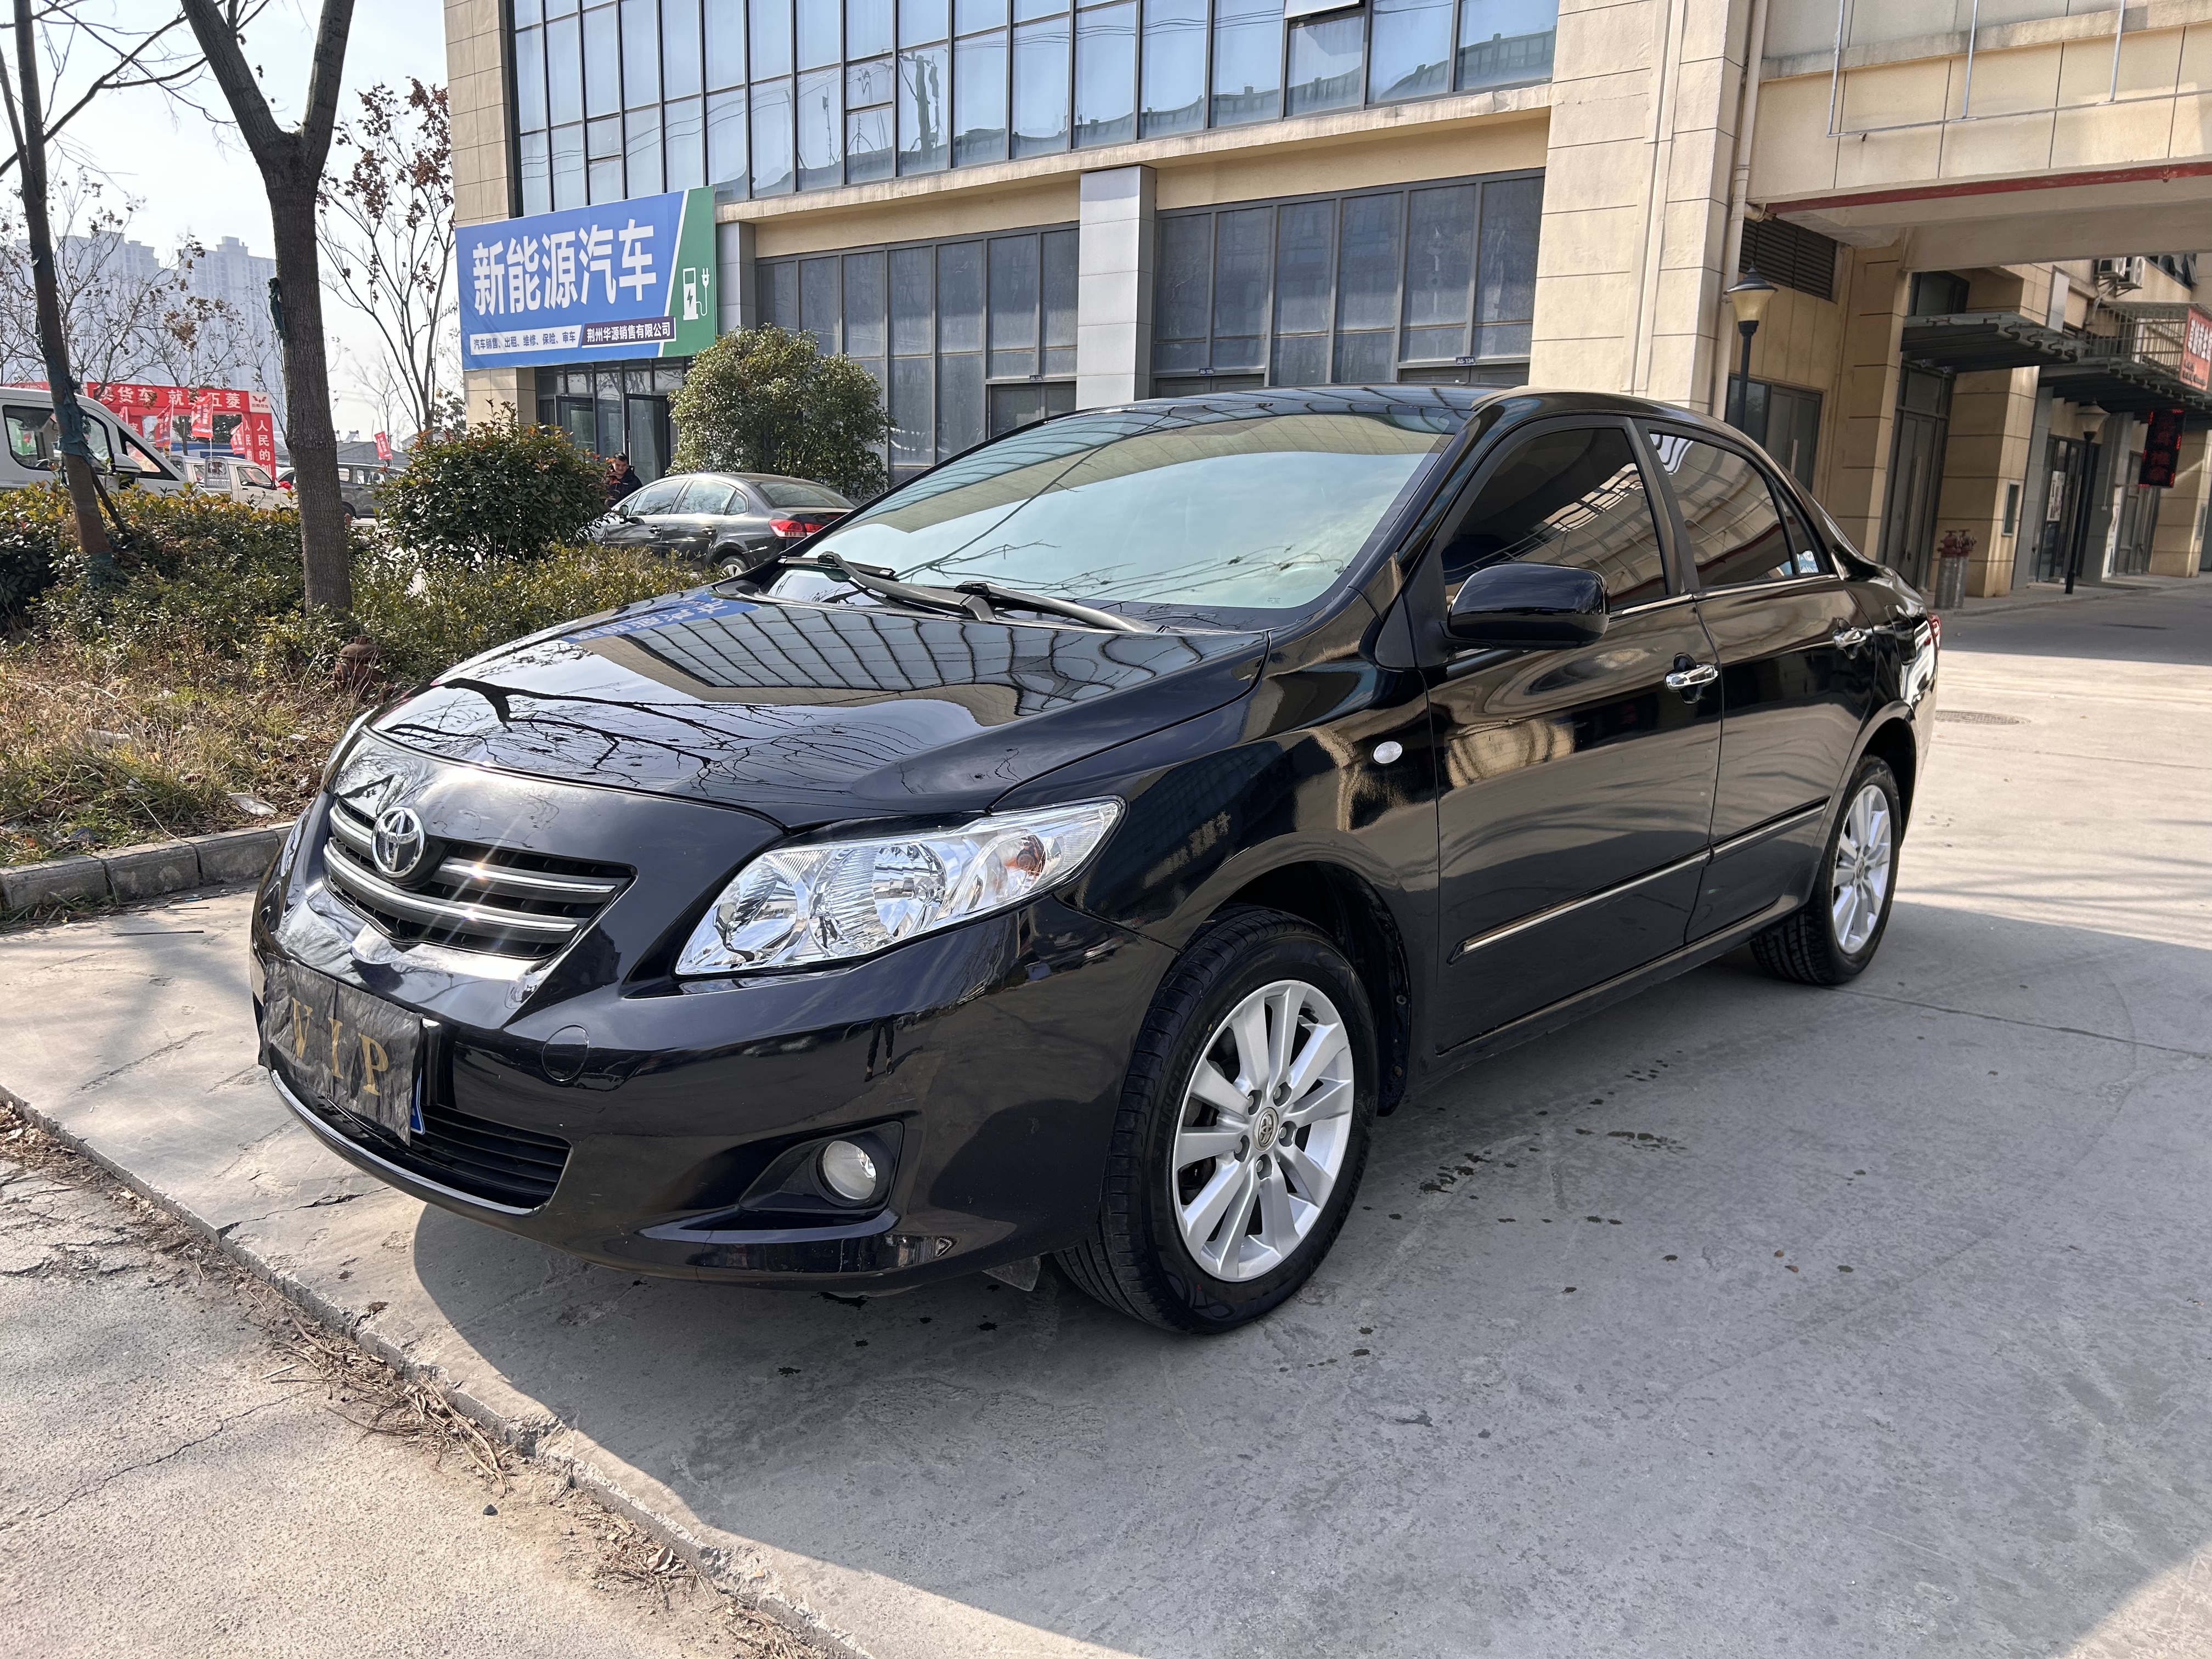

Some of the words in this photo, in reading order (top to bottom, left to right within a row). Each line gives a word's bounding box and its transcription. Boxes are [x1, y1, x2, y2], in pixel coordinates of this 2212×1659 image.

[473, 219, 657, 316] 新能源汽车
[586, 321, 670, 343] 荆州华源销售有限公司
[167, 390, 241, 409] 就五菱
[291, 996, 389, 1096] VIP
